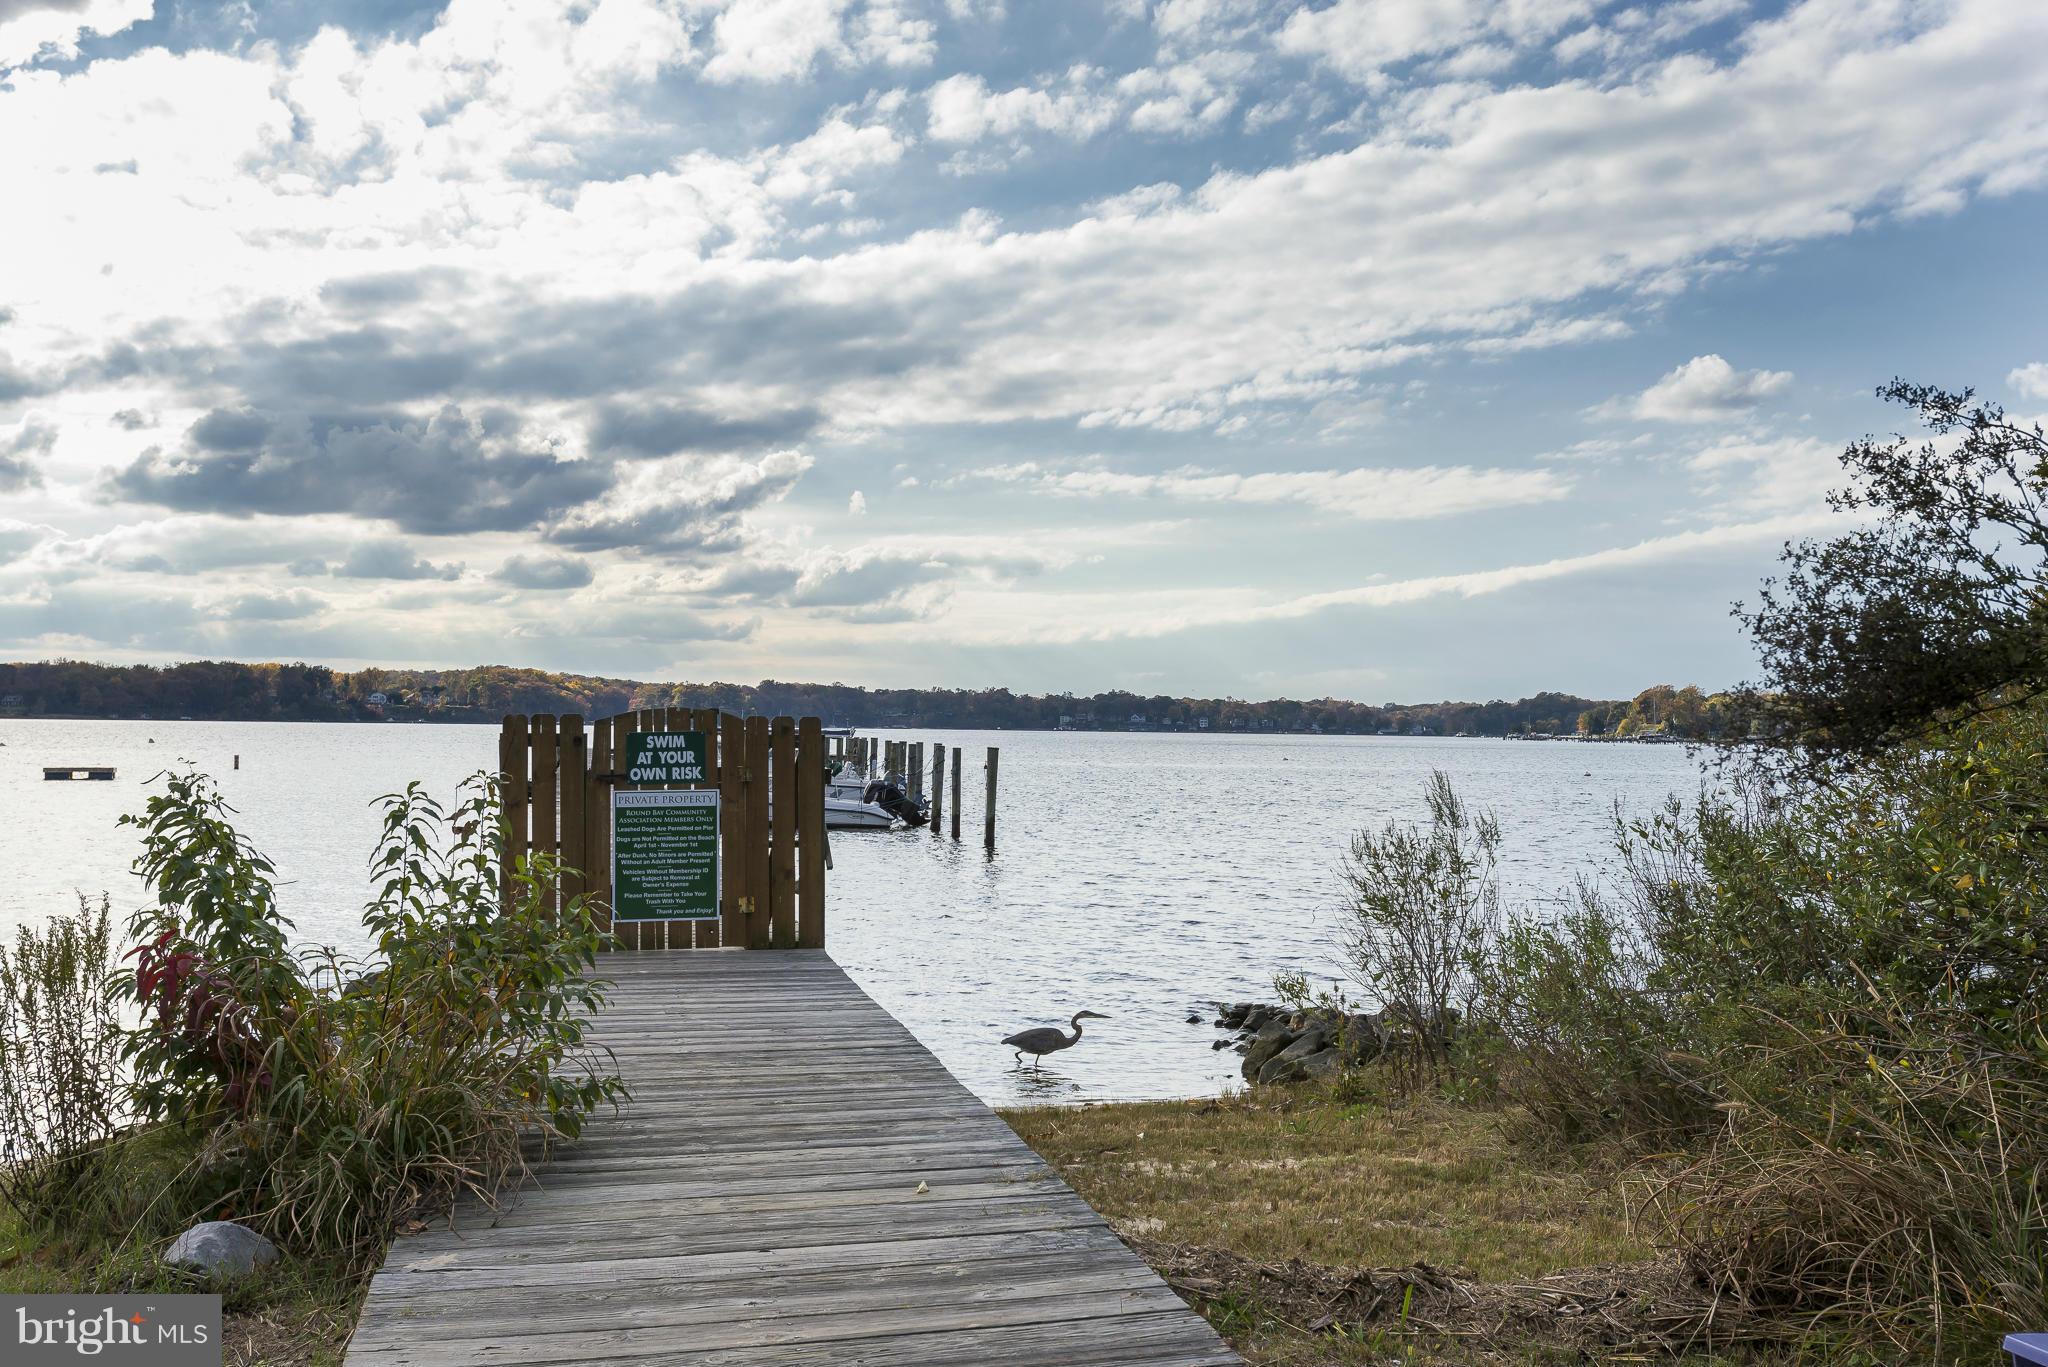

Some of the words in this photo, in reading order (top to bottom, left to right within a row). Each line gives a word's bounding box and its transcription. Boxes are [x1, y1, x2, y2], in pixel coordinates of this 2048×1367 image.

[647, 736, 685, 748] SWIM
[637, 752, 653, 764] AT
[658, 751, 695, 764] YOUR
[630, 768, 666, 780] OWN
[672, 767, 702, 779] RISK
[618, 796, 658, 804] PRIVATE
[662, 795, 714, 803] PROPERTY
